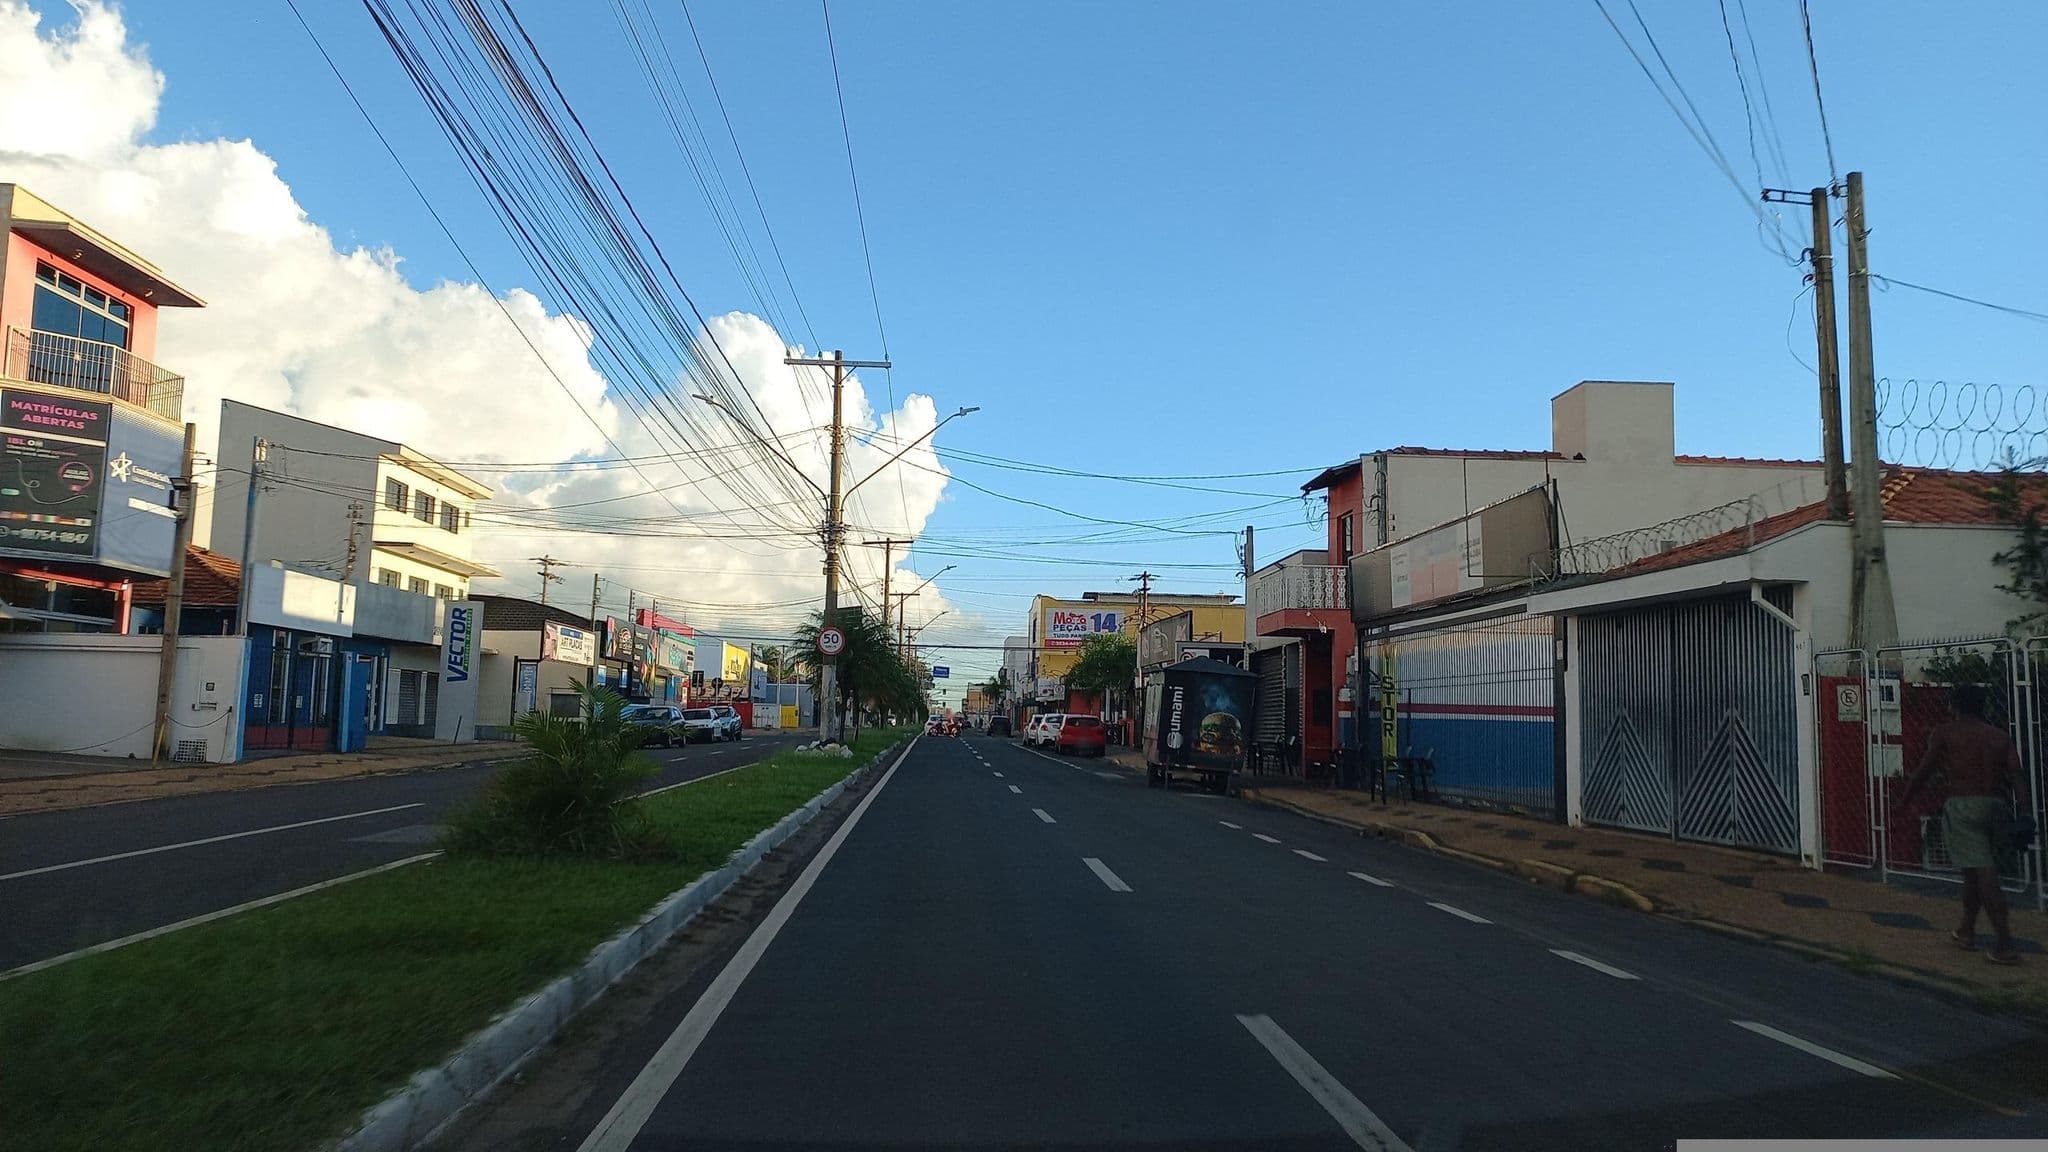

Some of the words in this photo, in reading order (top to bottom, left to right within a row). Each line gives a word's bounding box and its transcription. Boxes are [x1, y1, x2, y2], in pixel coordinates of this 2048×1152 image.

[10, 401, 98, 420] MATRÍCULAS
[22, 414, 86, 430] ABERTAS
[1053, 624, 1087, 632] PEÇAS
[1090, 613, 1117, 632] 14
[447, 607, 468, 683] VECTOR
[823, 633, 838, 644] 50
[1169, 686, 1184, 731] umami
